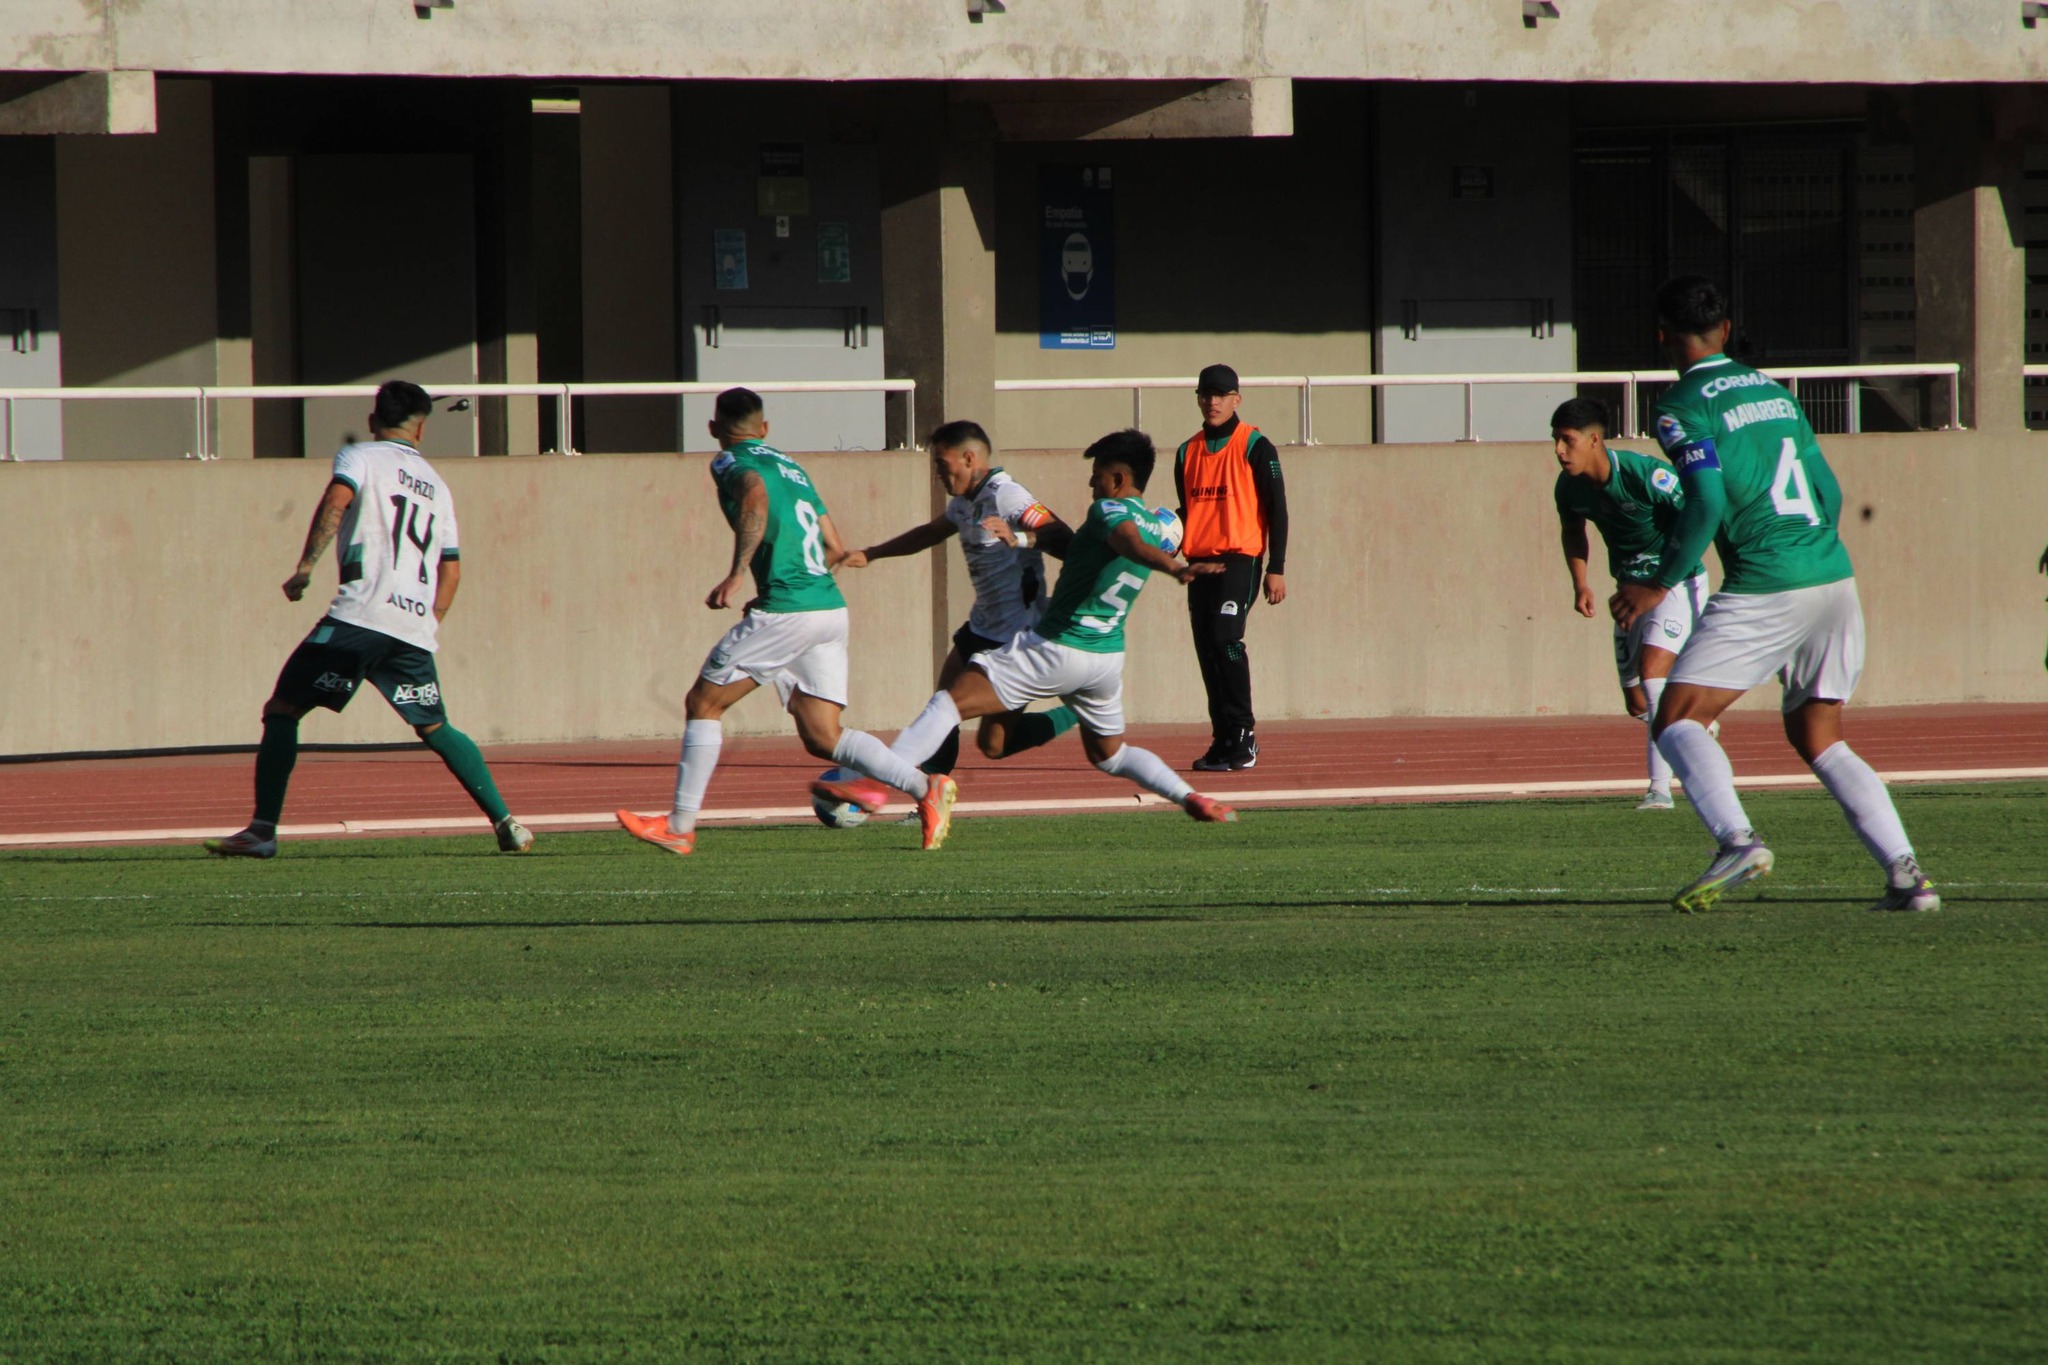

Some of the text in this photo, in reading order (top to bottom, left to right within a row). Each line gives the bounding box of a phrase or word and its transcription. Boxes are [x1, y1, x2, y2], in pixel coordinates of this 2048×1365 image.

[1770, 437, 1821, 526] 4
[389, 494, 435, 585] 14
[794, 499, 828, 576] 8
[386, 591, 426, 617] ALTO
[1079, 571, 1145, 634] 5
[393, 681, 439, 702] AZOTEA
